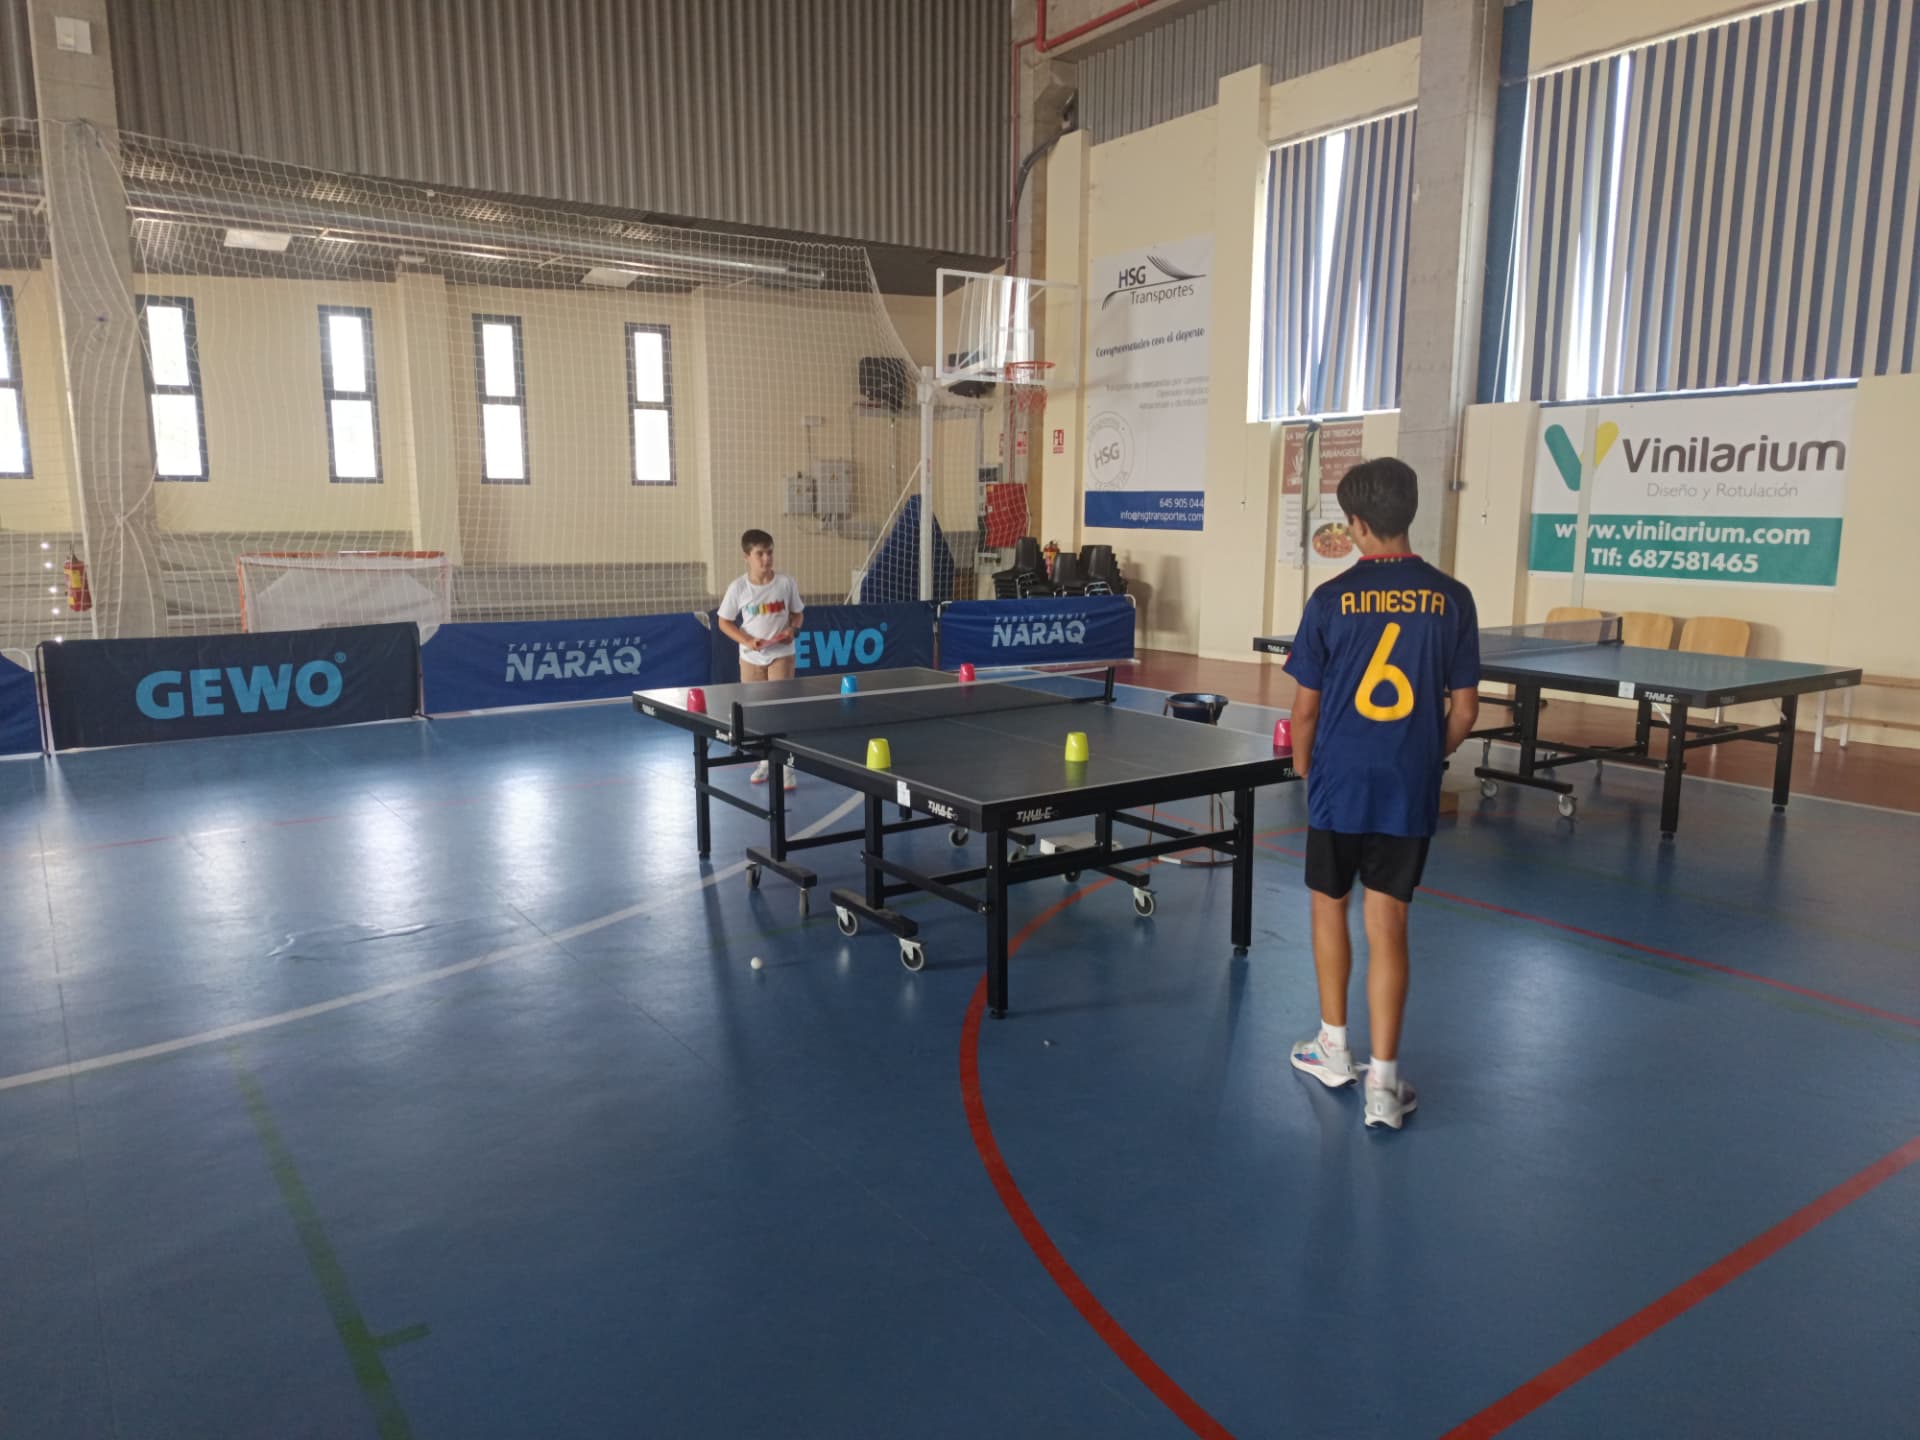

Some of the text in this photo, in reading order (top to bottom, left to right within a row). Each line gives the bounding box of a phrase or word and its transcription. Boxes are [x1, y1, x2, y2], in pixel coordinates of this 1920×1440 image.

[1118, 265, 1147, 289] HSG
[1130, 283, 1195, 305] Transportes
[1094, 442, 1121, 469] HSG
[1622, 434, 1847, 473] Vinilarium
[1646, 482, 1799, 500] Diseño y Rotulación
[1591, 547, 1760, 574] Tlf: 687581465
[1341, 589, 1445, 617] A.INIESTA
[508, 636, 642, 652] TABLE TENNIS
[992, 620, 1086, 648] NARAQ
[795, 628, 884, 669] EWO
[505, 646, 642, 683] NARAQ
[1354, 621, 1415, 723] 6
